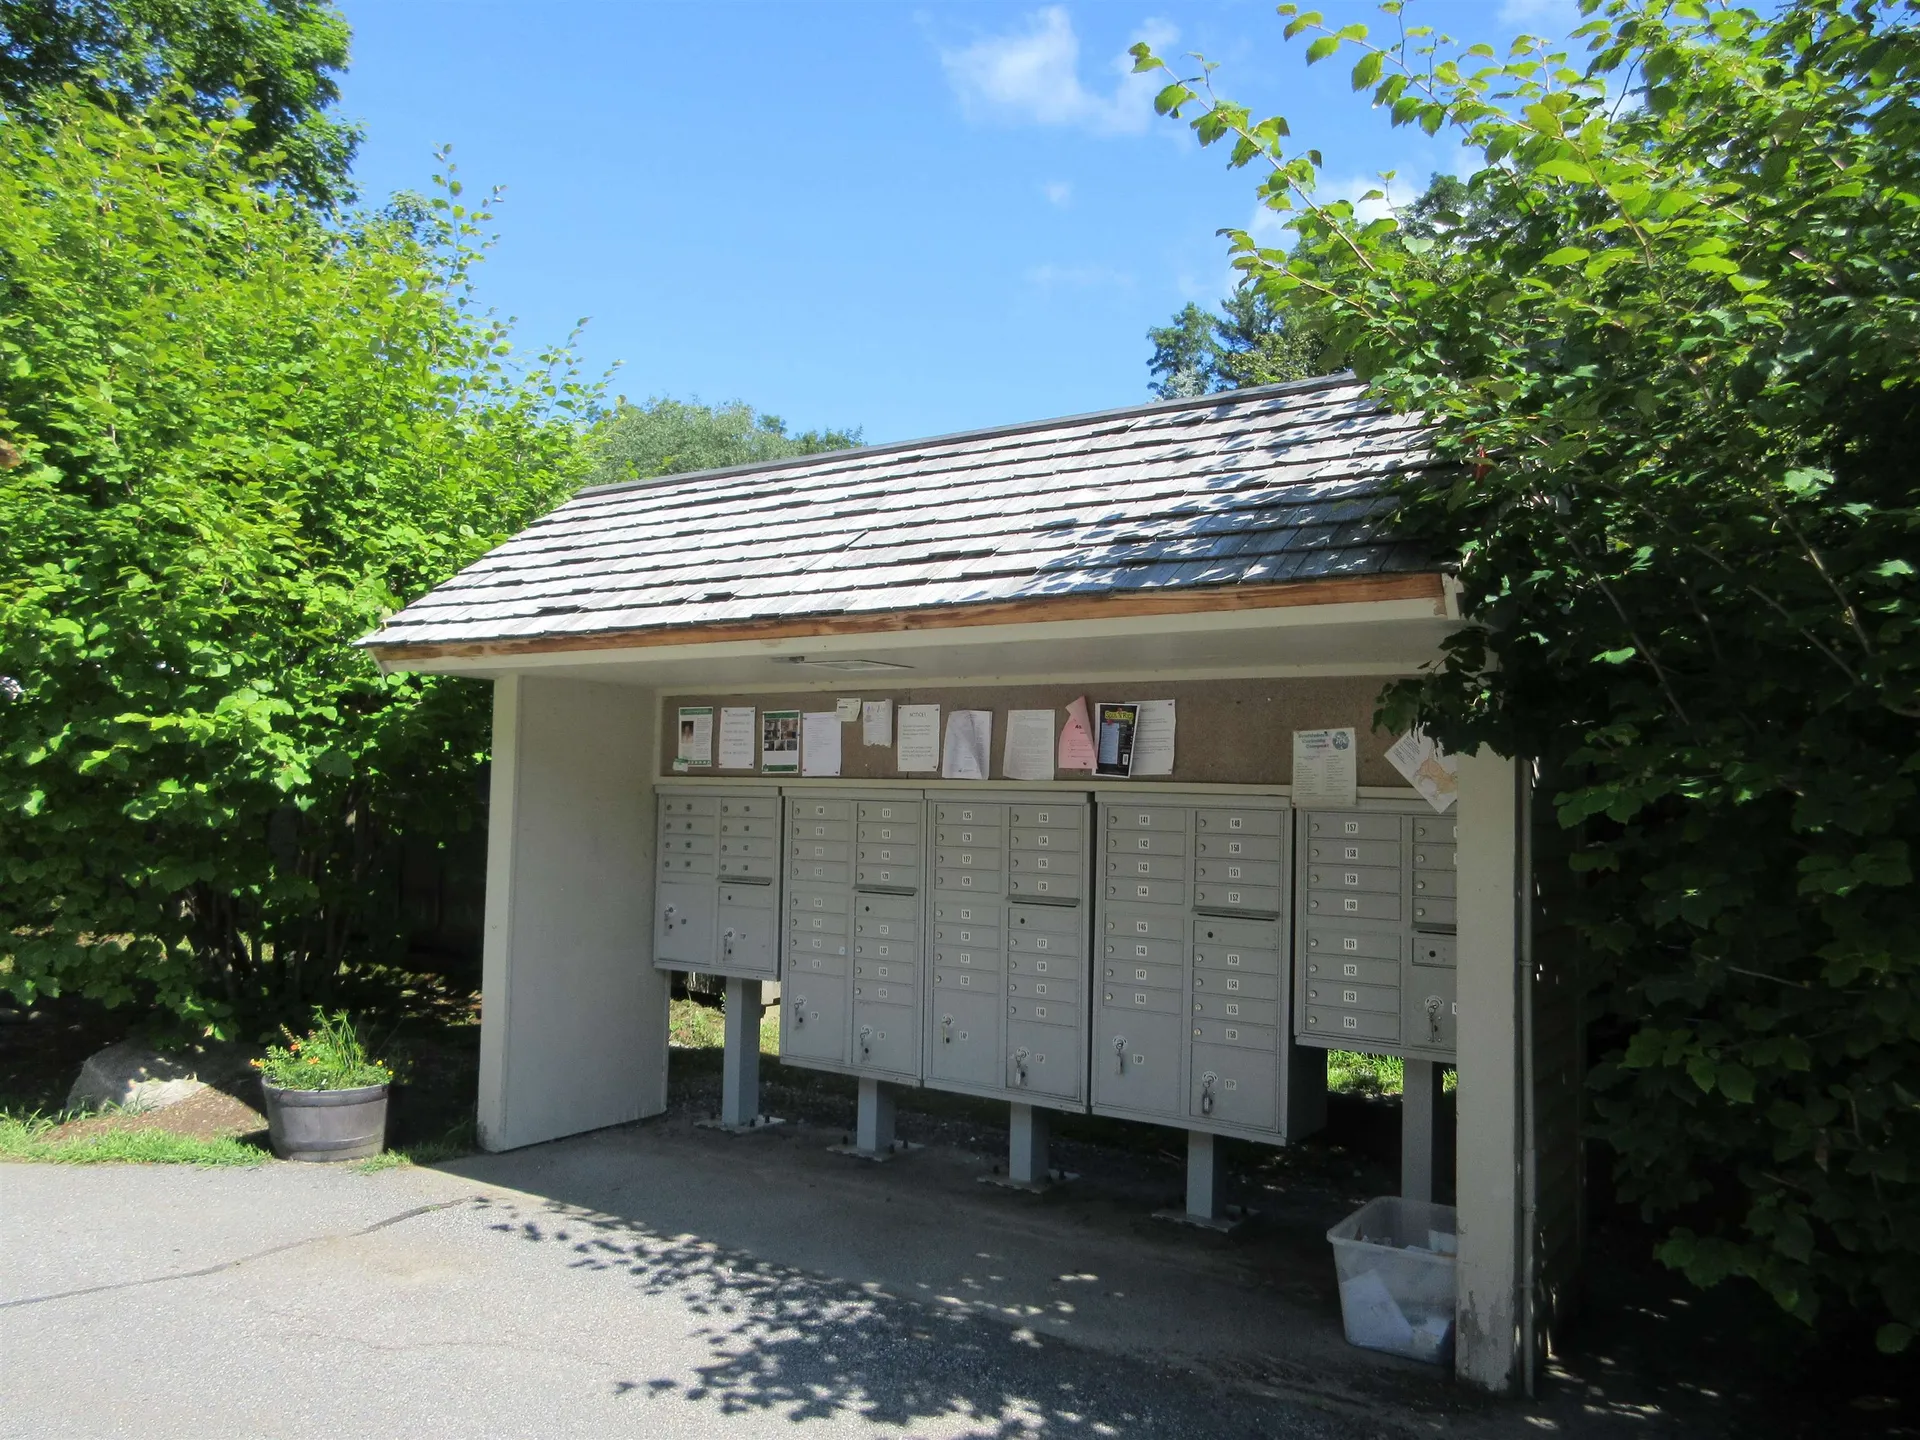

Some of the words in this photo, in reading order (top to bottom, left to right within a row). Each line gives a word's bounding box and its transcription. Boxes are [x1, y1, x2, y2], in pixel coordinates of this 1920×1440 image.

[1140, 815, 1149, 825] 141
[1346, 823, 1358, 833] 157
[1139, 839, 1149, 848] 142
[1346, 848, 1357, 858] 158
[1230, 867, 1240, 877] 151
[1138, 887, 1148, 896] 144
[1229, 893, 1240, 902] 152
[1137, 922, 1147, 932] 145
[1345, 939, 1356, 949] 161
[1228, 955, 1239, 965] 153
[1136, 970, 1146, 980] 147
[1228, 979, 1238, 990] 154
[1345, 991, 1356, 1002] 163
[1227, 1005, 1238, 1015] 155
[1345, 1017, 1356, 1028] 164
